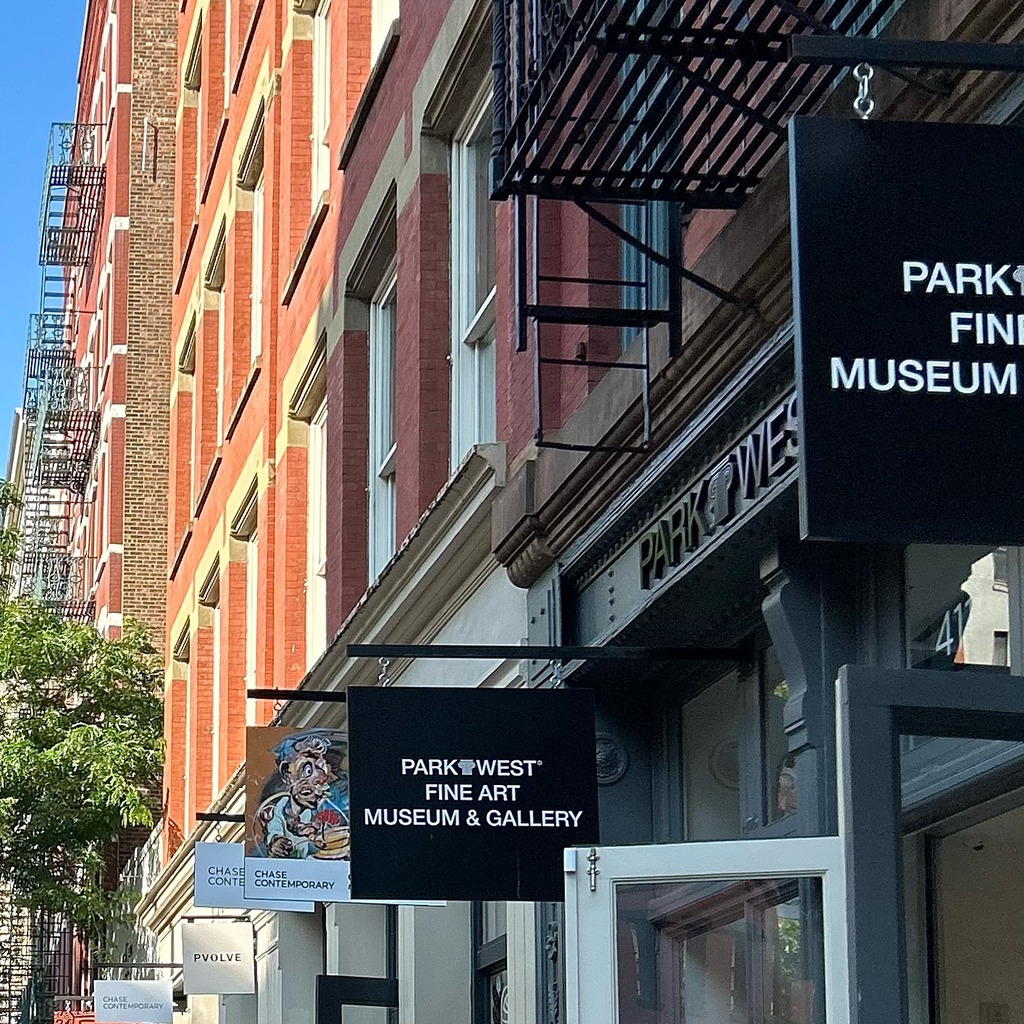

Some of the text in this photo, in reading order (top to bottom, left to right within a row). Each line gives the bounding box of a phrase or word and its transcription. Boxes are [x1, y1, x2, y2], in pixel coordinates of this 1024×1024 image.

[903, 261, 1014, 296] PARK
[831, 357, 1018, 395] MUSEUM
[639, 479, 714, 590] PARK
[401, 758, 459, 776] PARK
[425, 783, 521, 802] FINE ART
[364, 808, 584, 828] MUSEUM & GALLERY
[208, 866, 245, 877] CHASE
[254, 870, 288, 880] CHASE
[254, 879, 335, 890] CONTEMPORARY
[193, 953, 242, 963] PVOLVE
